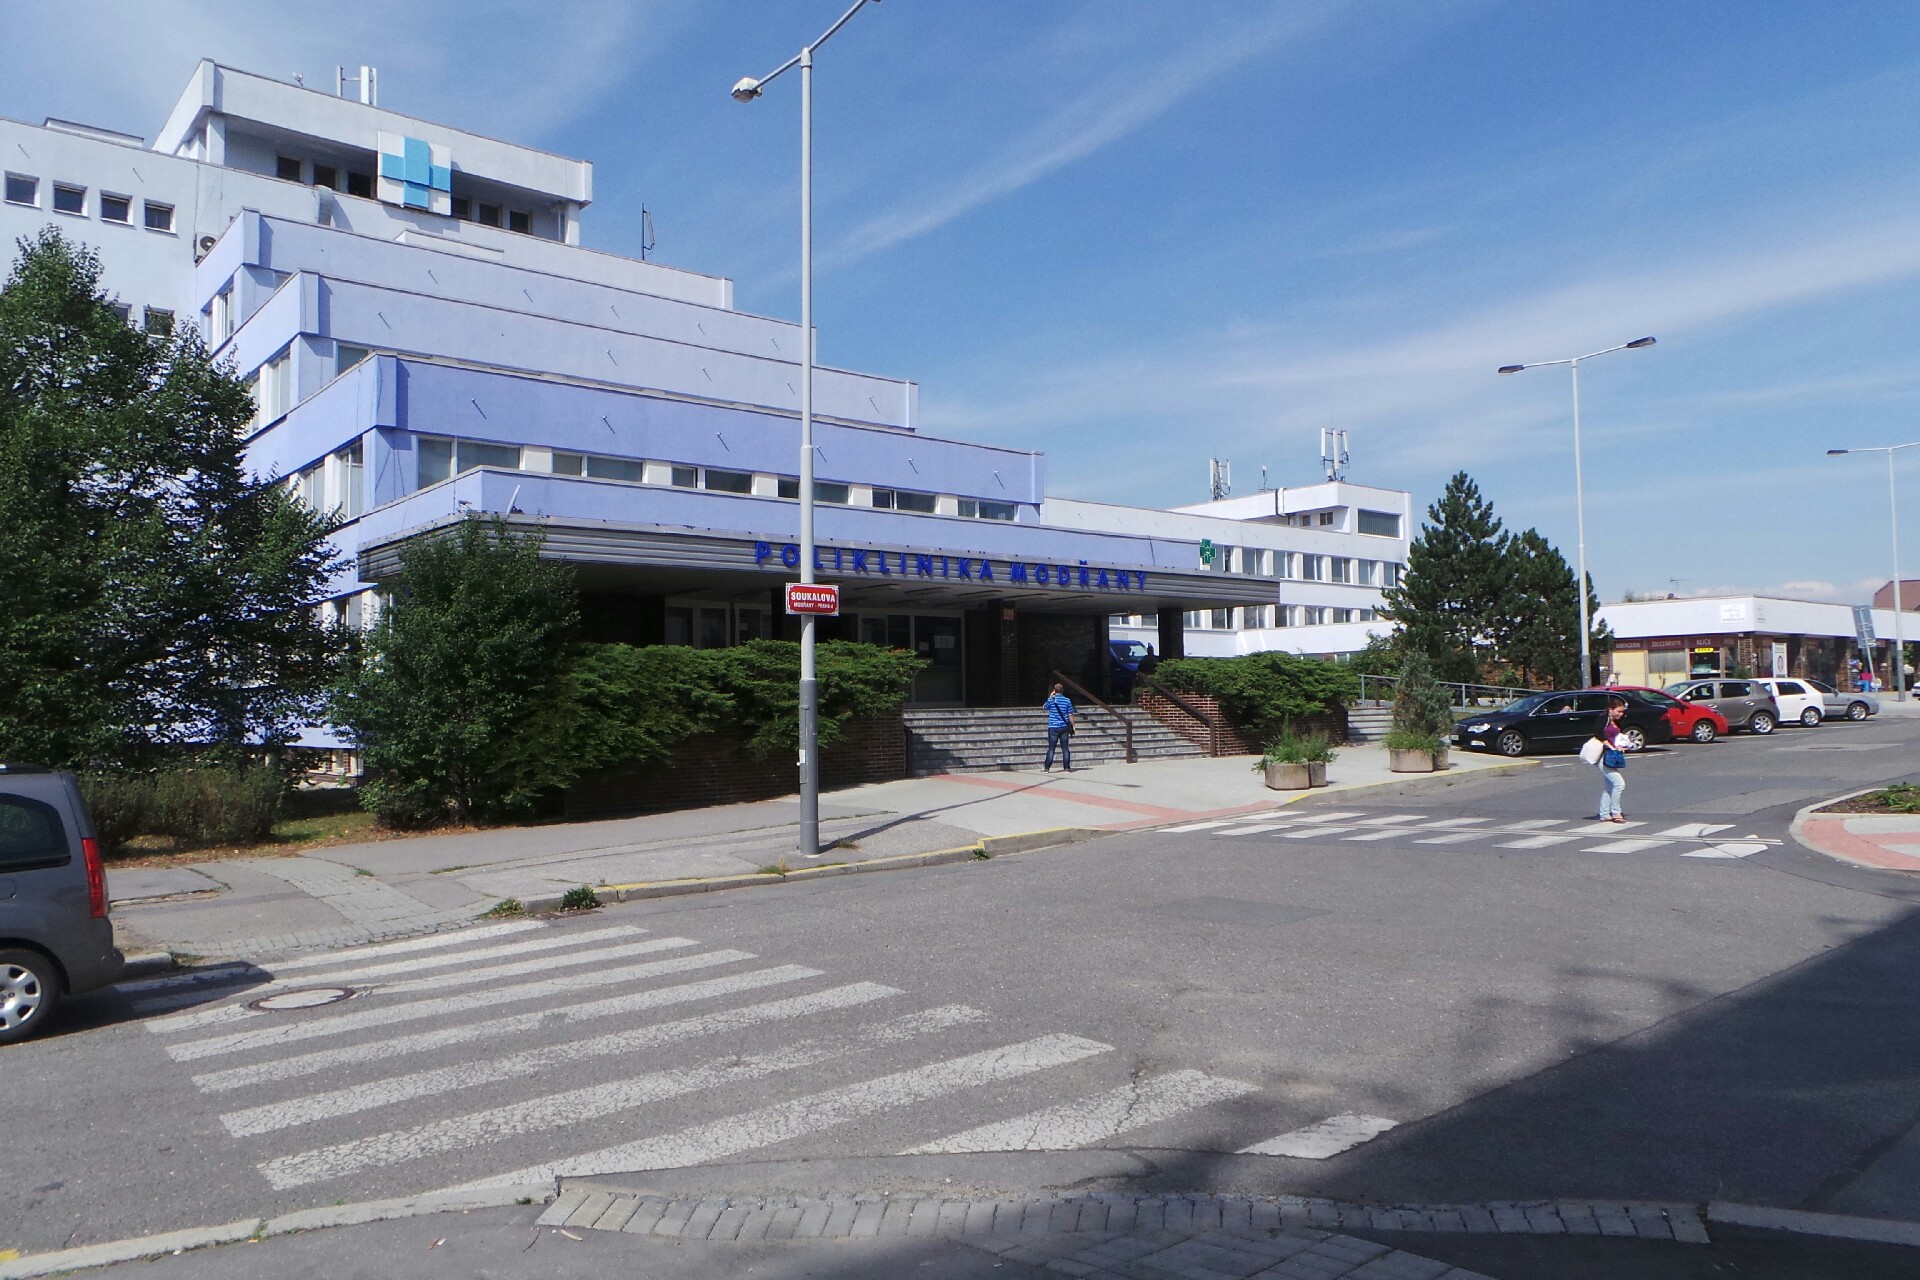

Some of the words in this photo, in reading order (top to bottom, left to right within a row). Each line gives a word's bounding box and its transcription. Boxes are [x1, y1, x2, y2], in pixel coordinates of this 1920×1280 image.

[755, 541, 993, 581] POLIKLINIKA
[1011, 559, 1146, 590] MODŘANY
[791, 592, 835, 602] SOUKALOVA
